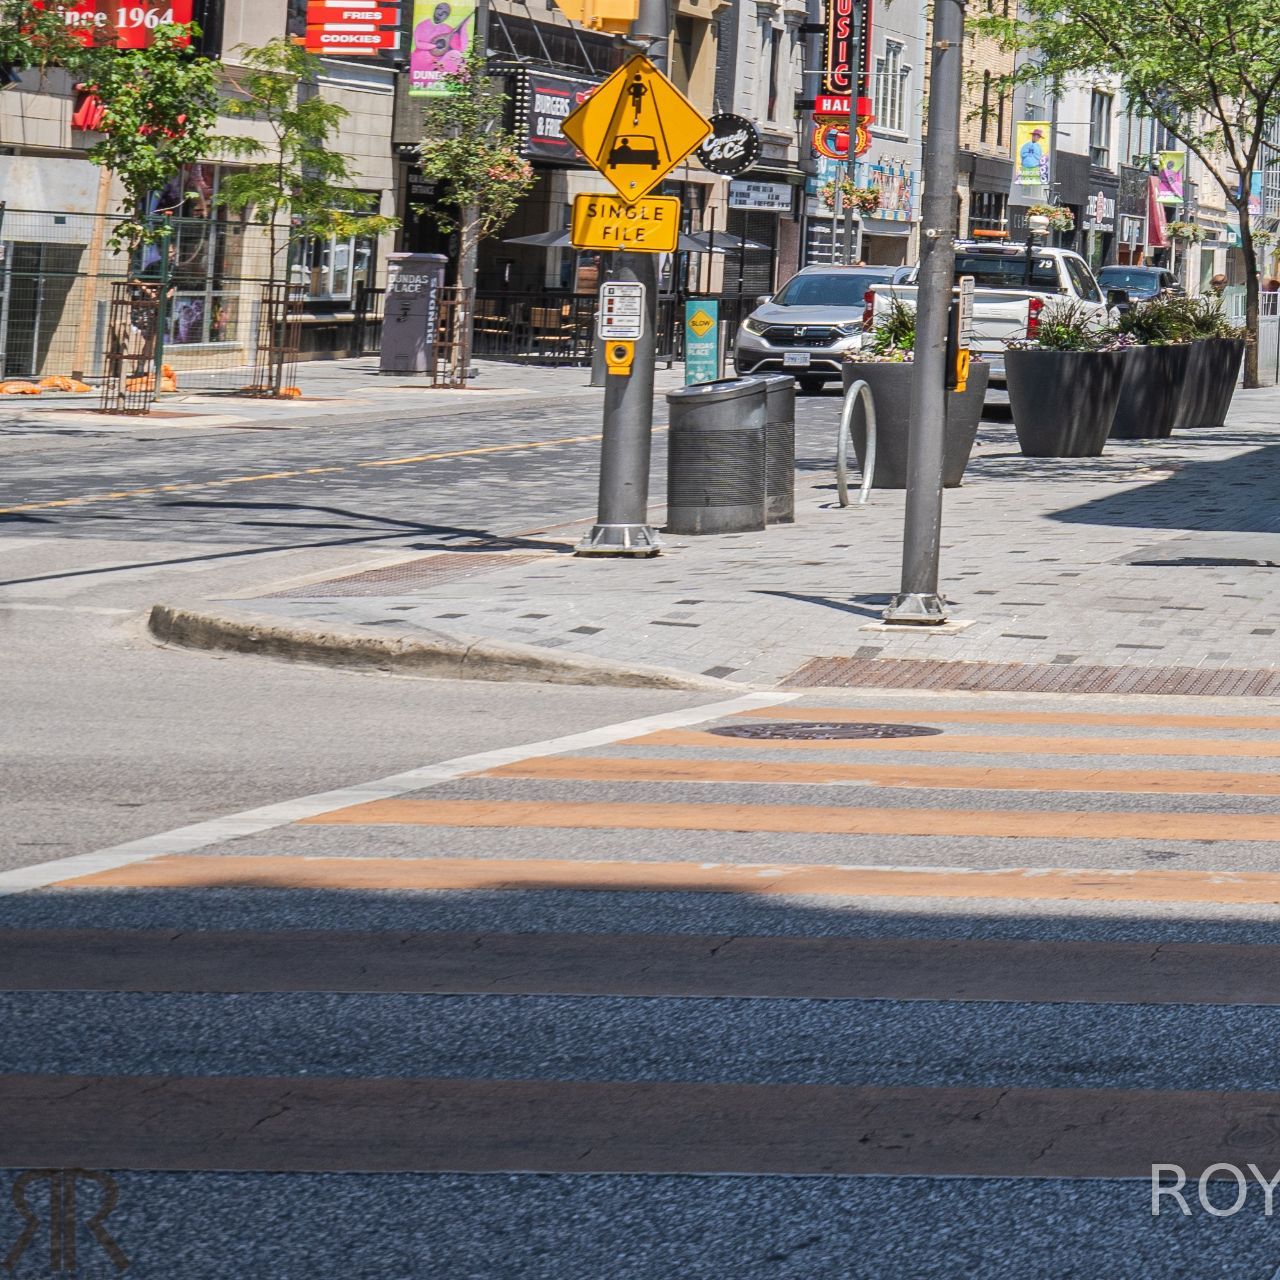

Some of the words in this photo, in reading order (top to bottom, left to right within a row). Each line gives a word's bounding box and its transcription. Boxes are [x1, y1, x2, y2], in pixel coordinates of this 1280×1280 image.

[54, 5, 107, 29] ince
[116, 6, 175, 30] 1964
[342, 11, 382, 20] FRIES
[320, 34, 382, 44] COOKIES
[534, 94, 570, 115] BURGERS
[822, 99, 852, 112] HAL
[702, 129, 749, 152] Comedy
[587, 203, 664, 222] SINGLE
[602, 226, 646, 242] FILE
[1038, 259, 1053, 269] 79
[389, 274, 430, 284] DUNDAS
[387, 283, 422, 293] PLACE
[425, 276, 438, 345] DUNDAS
